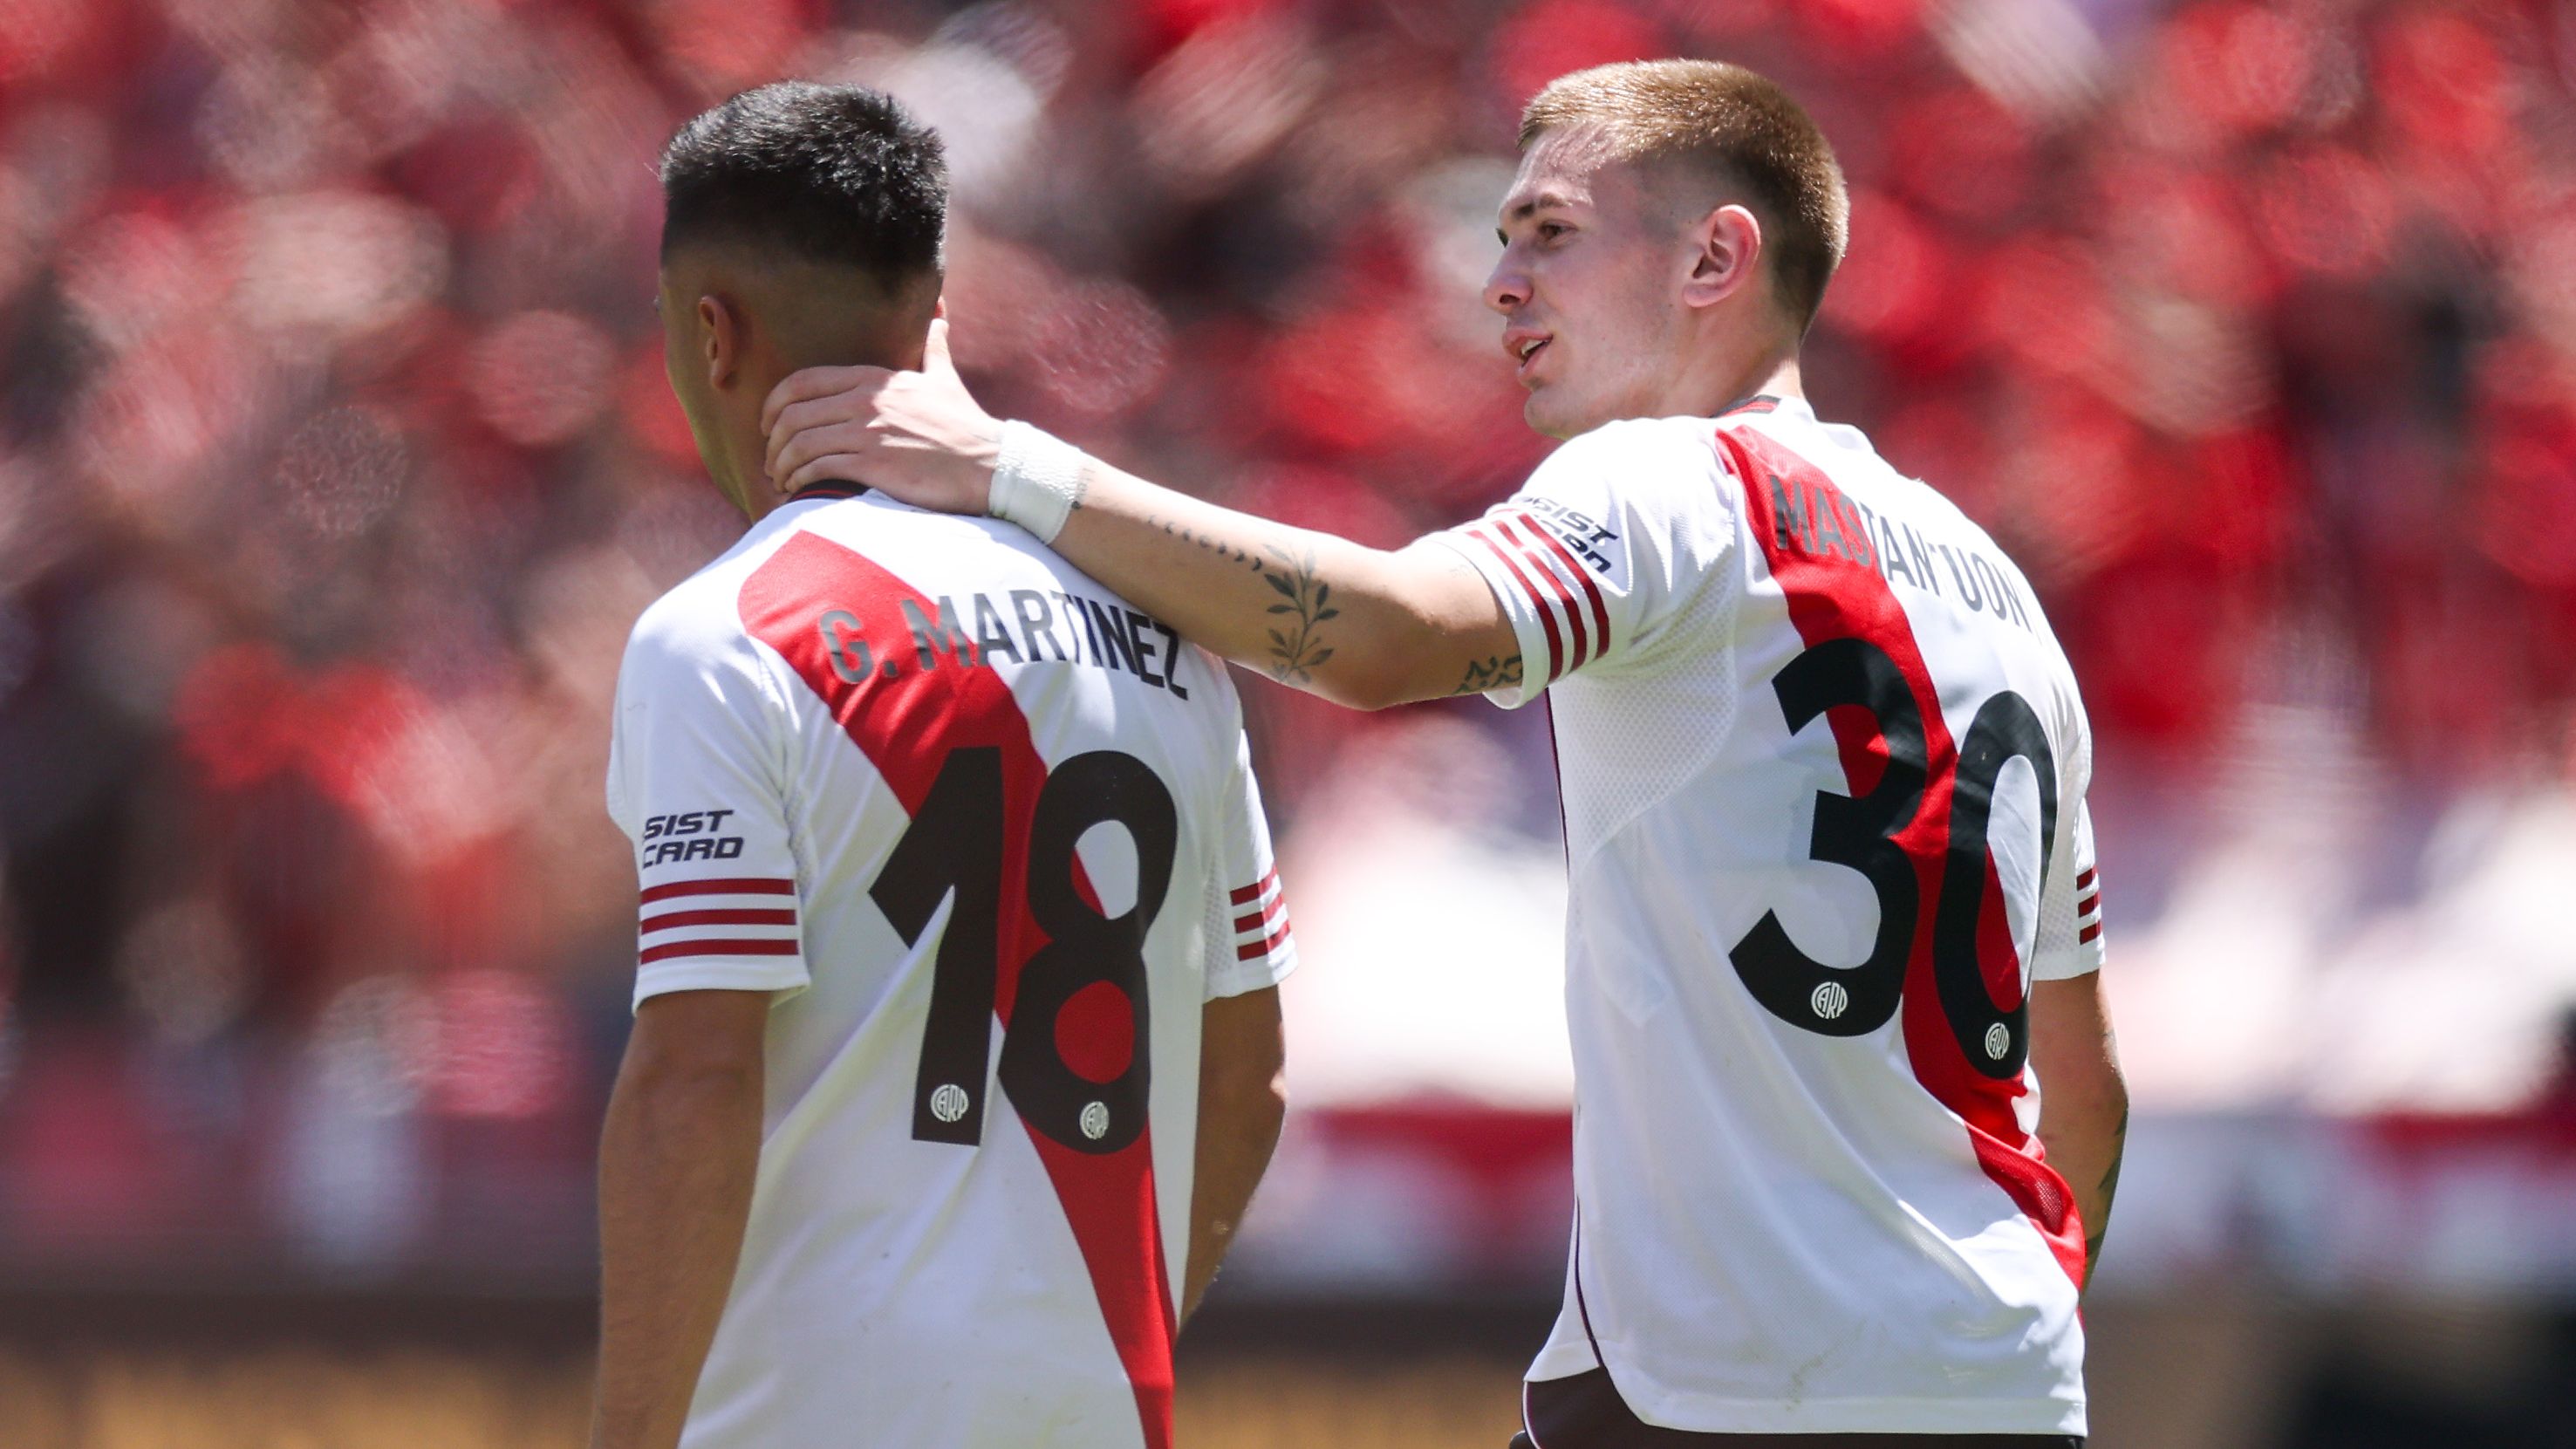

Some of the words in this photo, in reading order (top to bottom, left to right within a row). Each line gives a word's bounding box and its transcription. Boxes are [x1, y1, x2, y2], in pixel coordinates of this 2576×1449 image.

[819, 610, 899, 684] G.
[901, 589, 1188, 701] MARTINEZ
[1770, 475, 2040, 639] MASTANUON
[868, 746, 1178, 1154] 18
[1728, 638, 2057, 1080] 30
